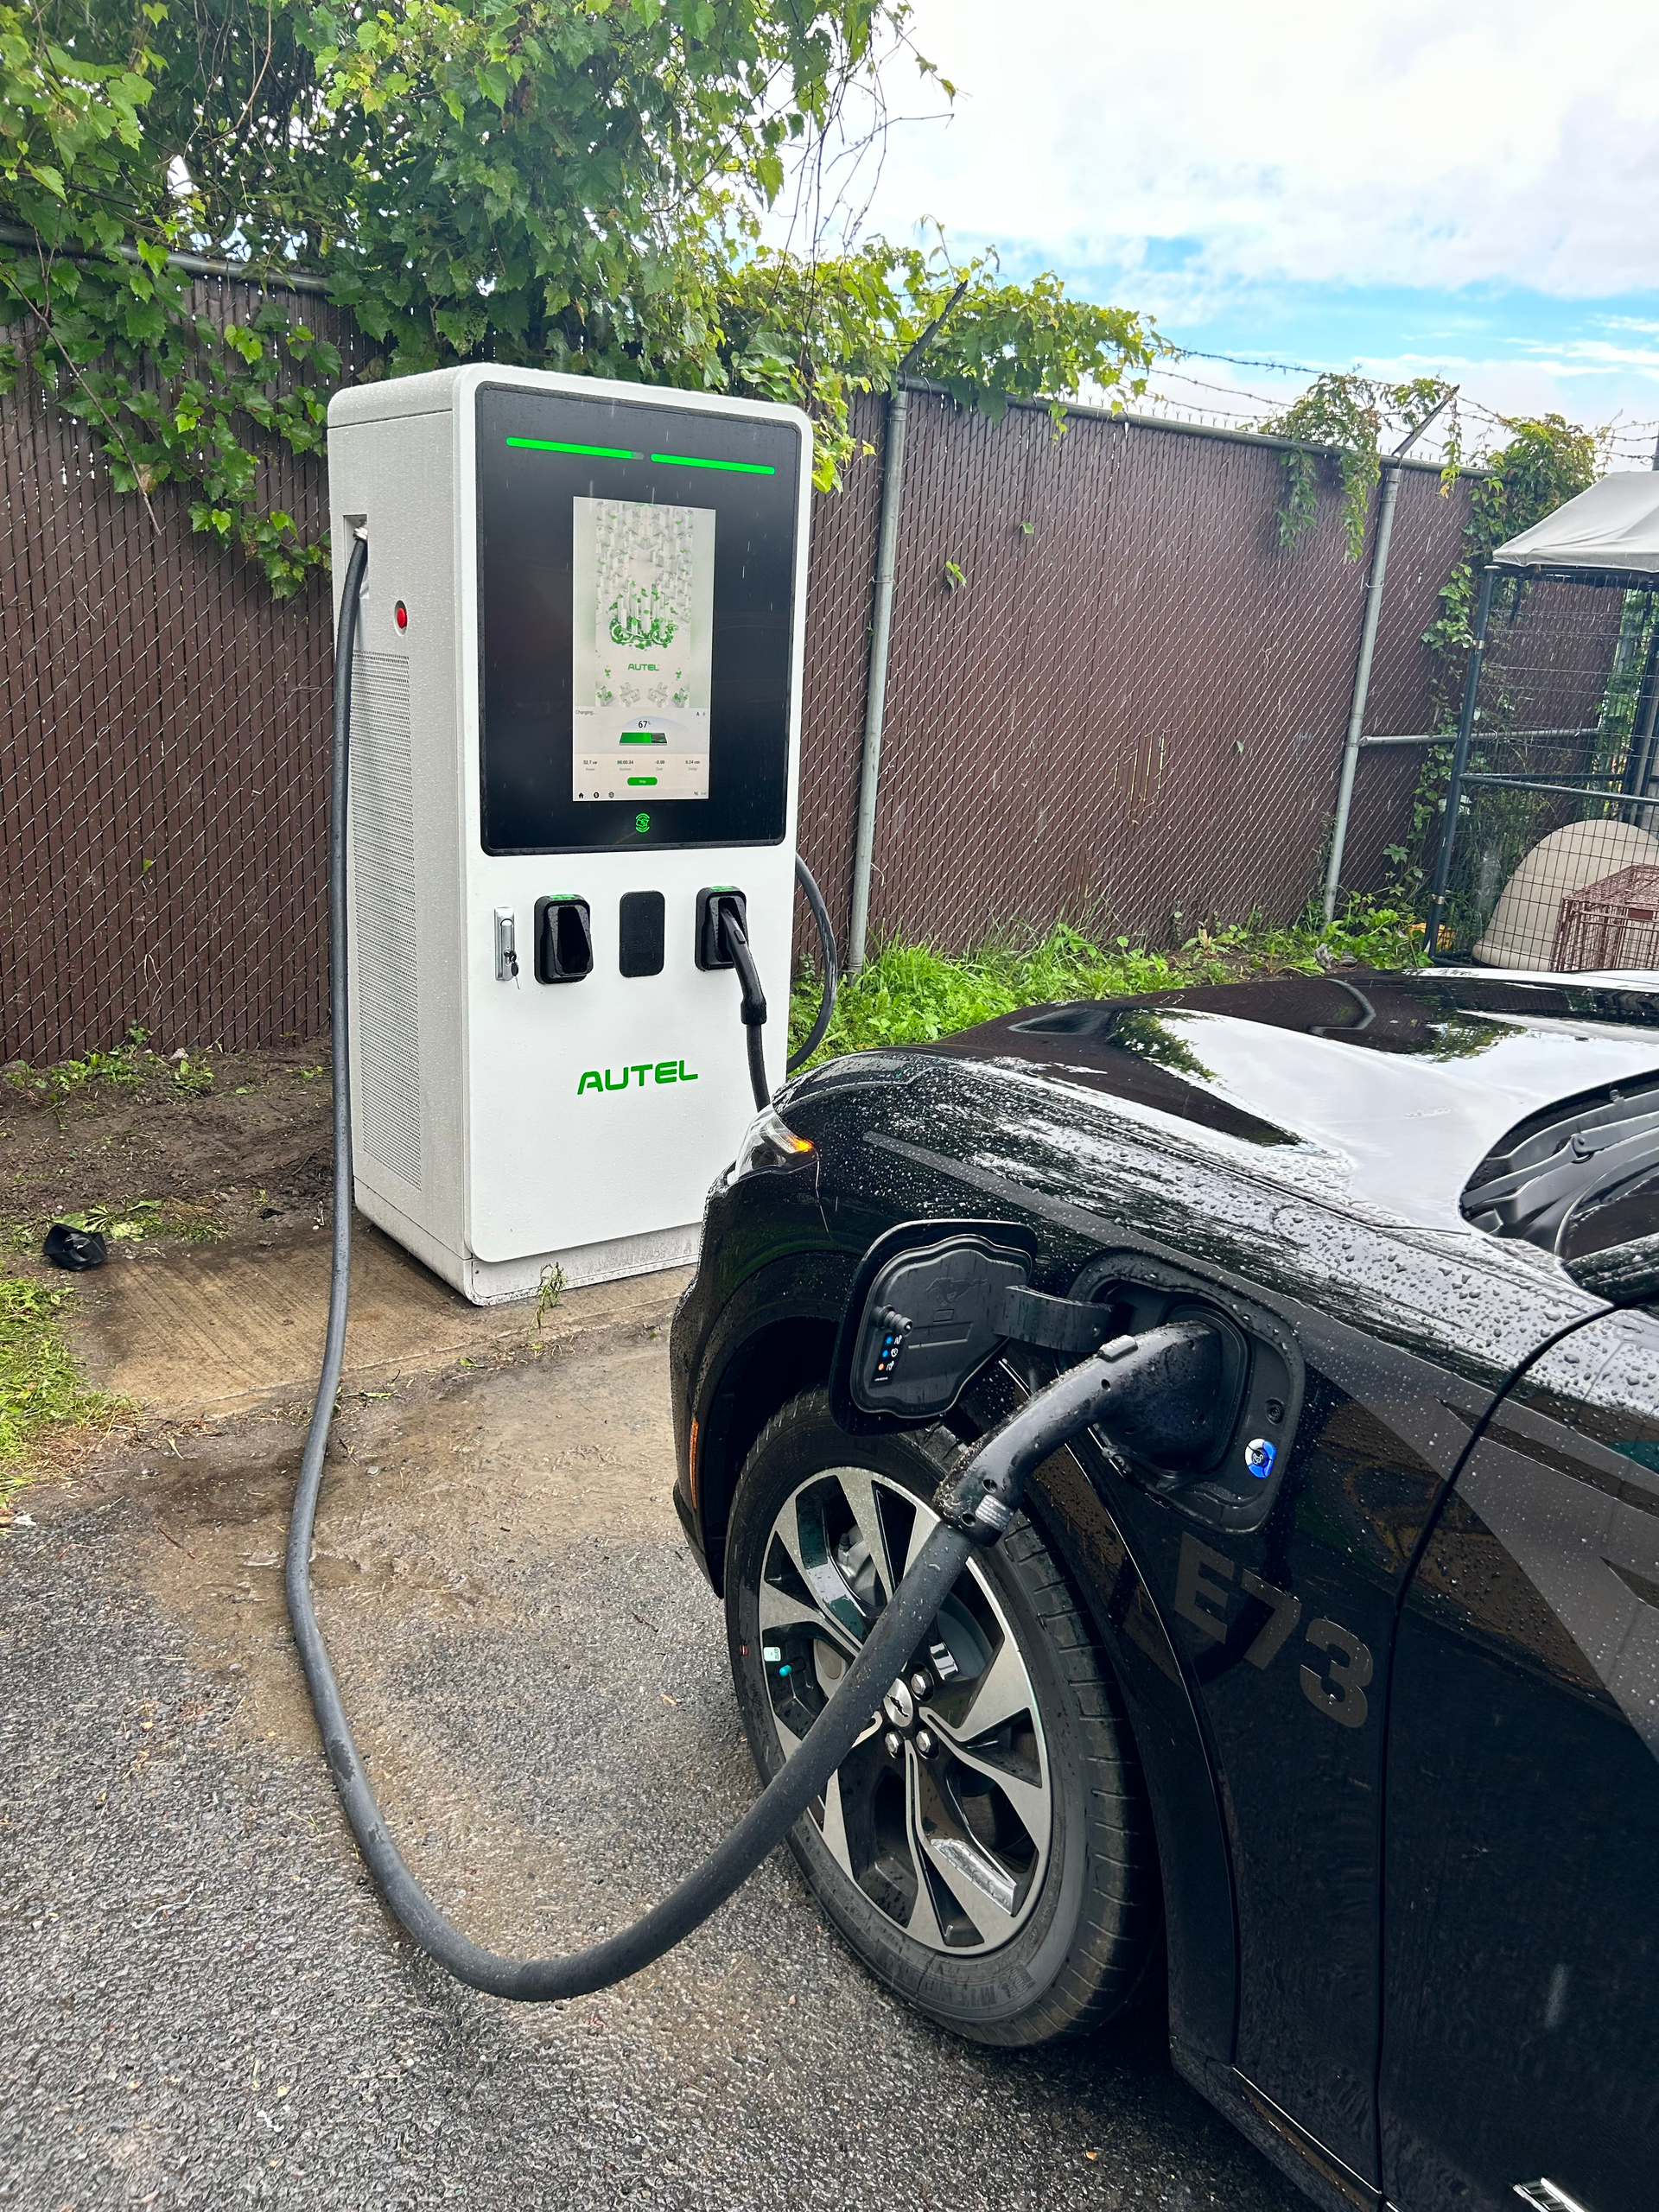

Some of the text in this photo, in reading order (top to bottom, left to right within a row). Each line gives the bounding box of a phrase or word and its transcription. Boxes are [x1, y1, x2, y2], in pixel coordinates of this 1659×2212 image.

[627, 663, 659, 671] AUTEL
[577, 1059, 699, 1096] AUTEL
[1174, 1531, 1374, 1728] E73
